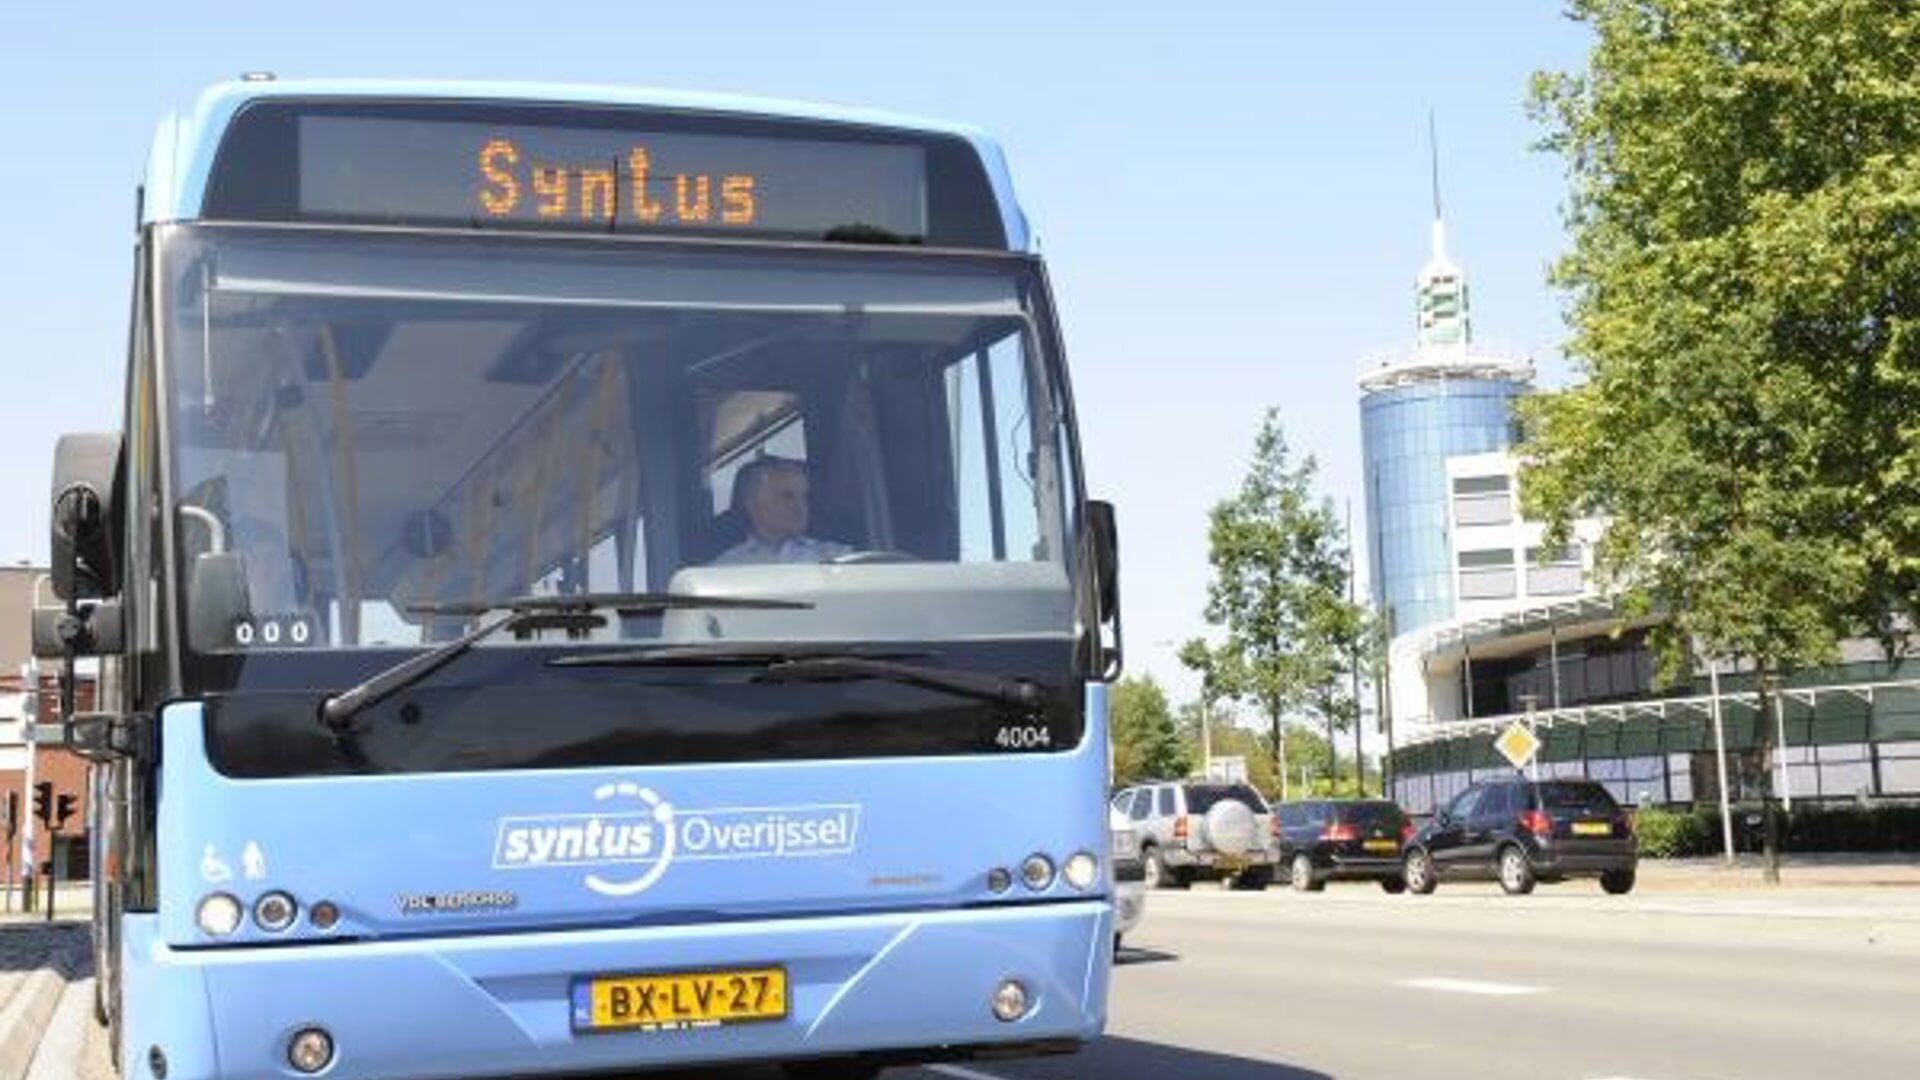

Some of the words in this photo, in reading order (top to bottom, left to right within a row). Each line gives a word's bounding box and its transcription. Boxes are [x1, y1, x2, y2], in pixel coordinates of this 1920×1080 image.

[479, 139, 756, 224] Syntus
[995, 727, 1050, 747] 4004
[504, 819, 653, 863] syntus
[682, 813, 847, 855] Overijssel
[611, 976, 770, 1019] BX-LV-27
